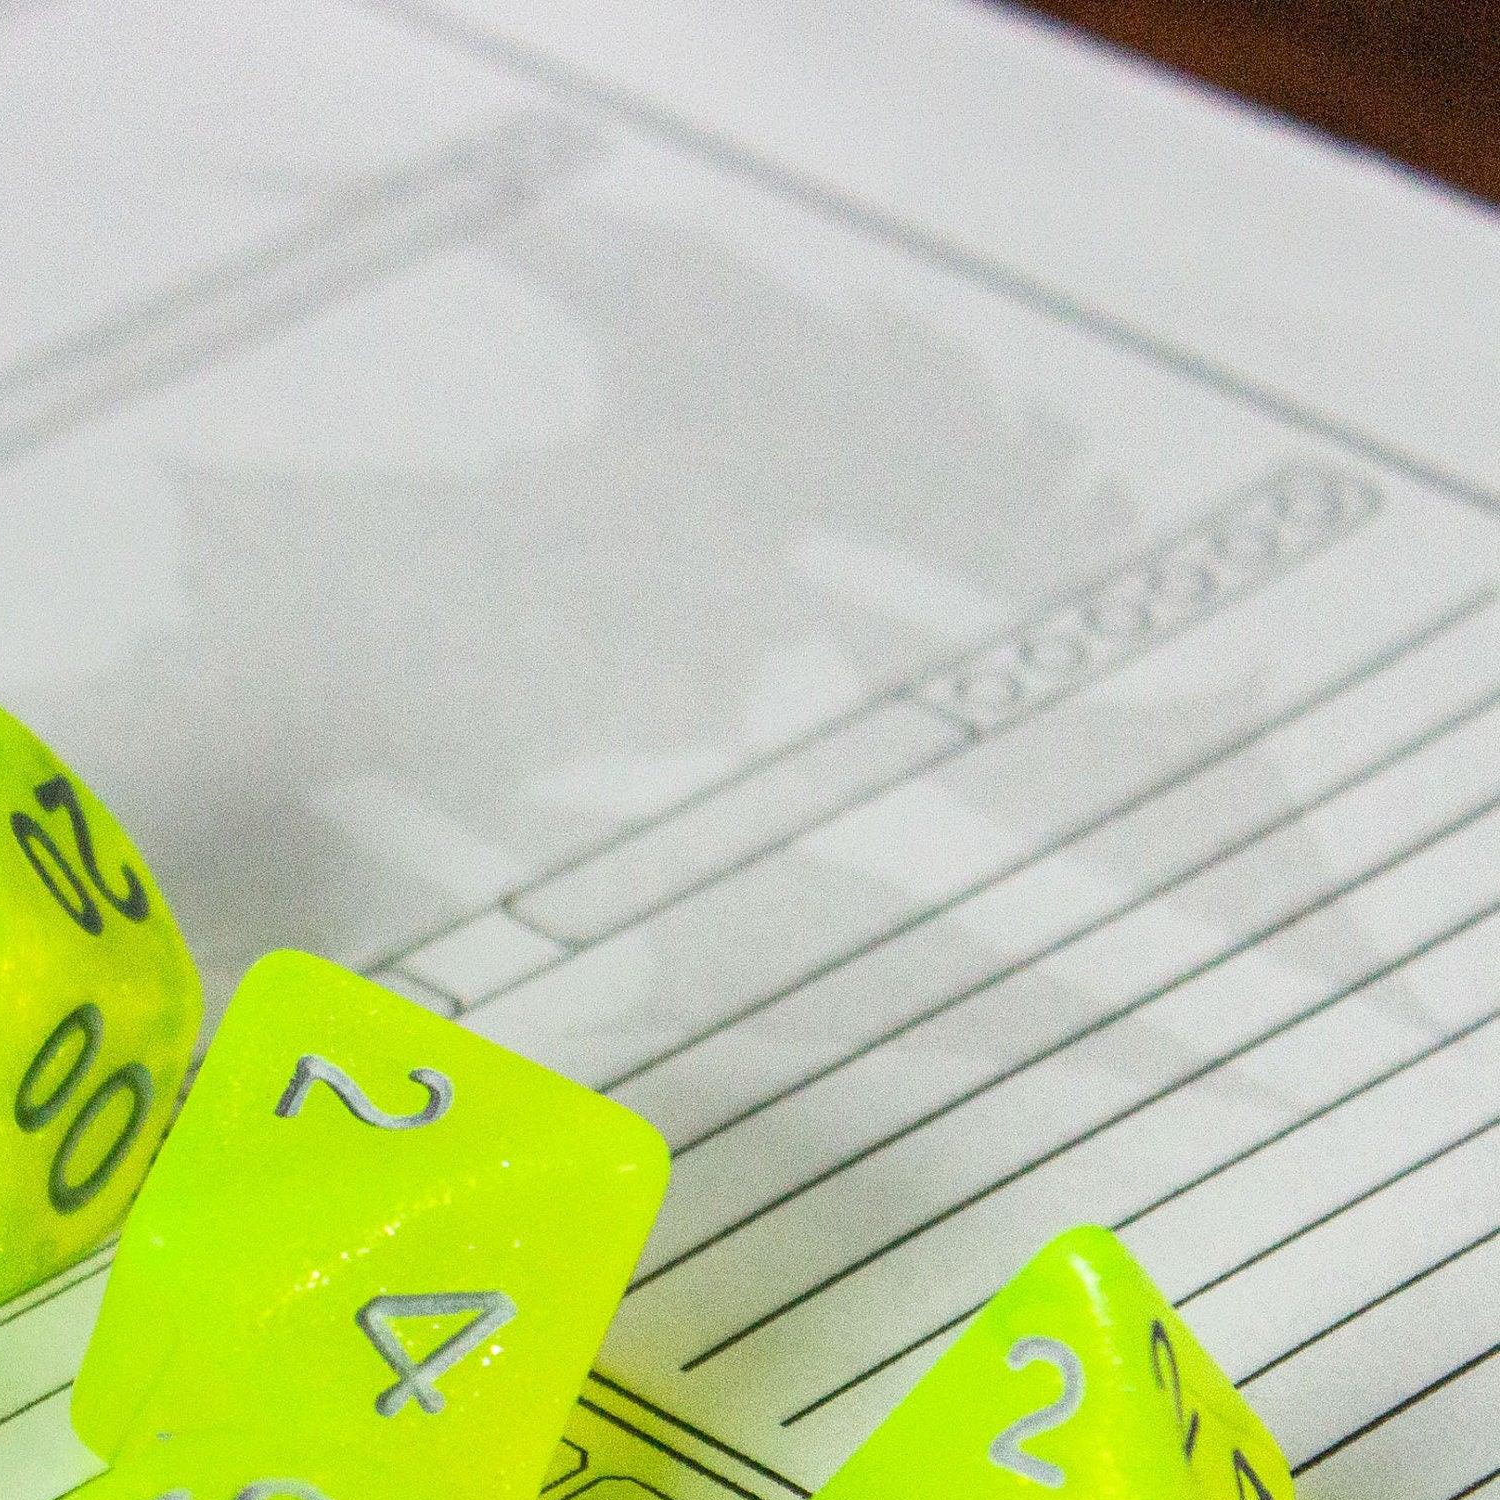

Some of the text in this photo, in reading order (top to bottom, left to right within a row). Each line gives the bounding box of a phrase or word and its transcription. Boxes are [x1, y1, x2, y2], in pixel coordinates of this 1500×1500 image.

[9, 773, 150, 935] 20
[13, 1003, 155, 1215] 00
[274, 1054, 454, 1131] 2
[354, 1289, 518, 1418] 4
[988, 1335, 1086, 1490] 2
